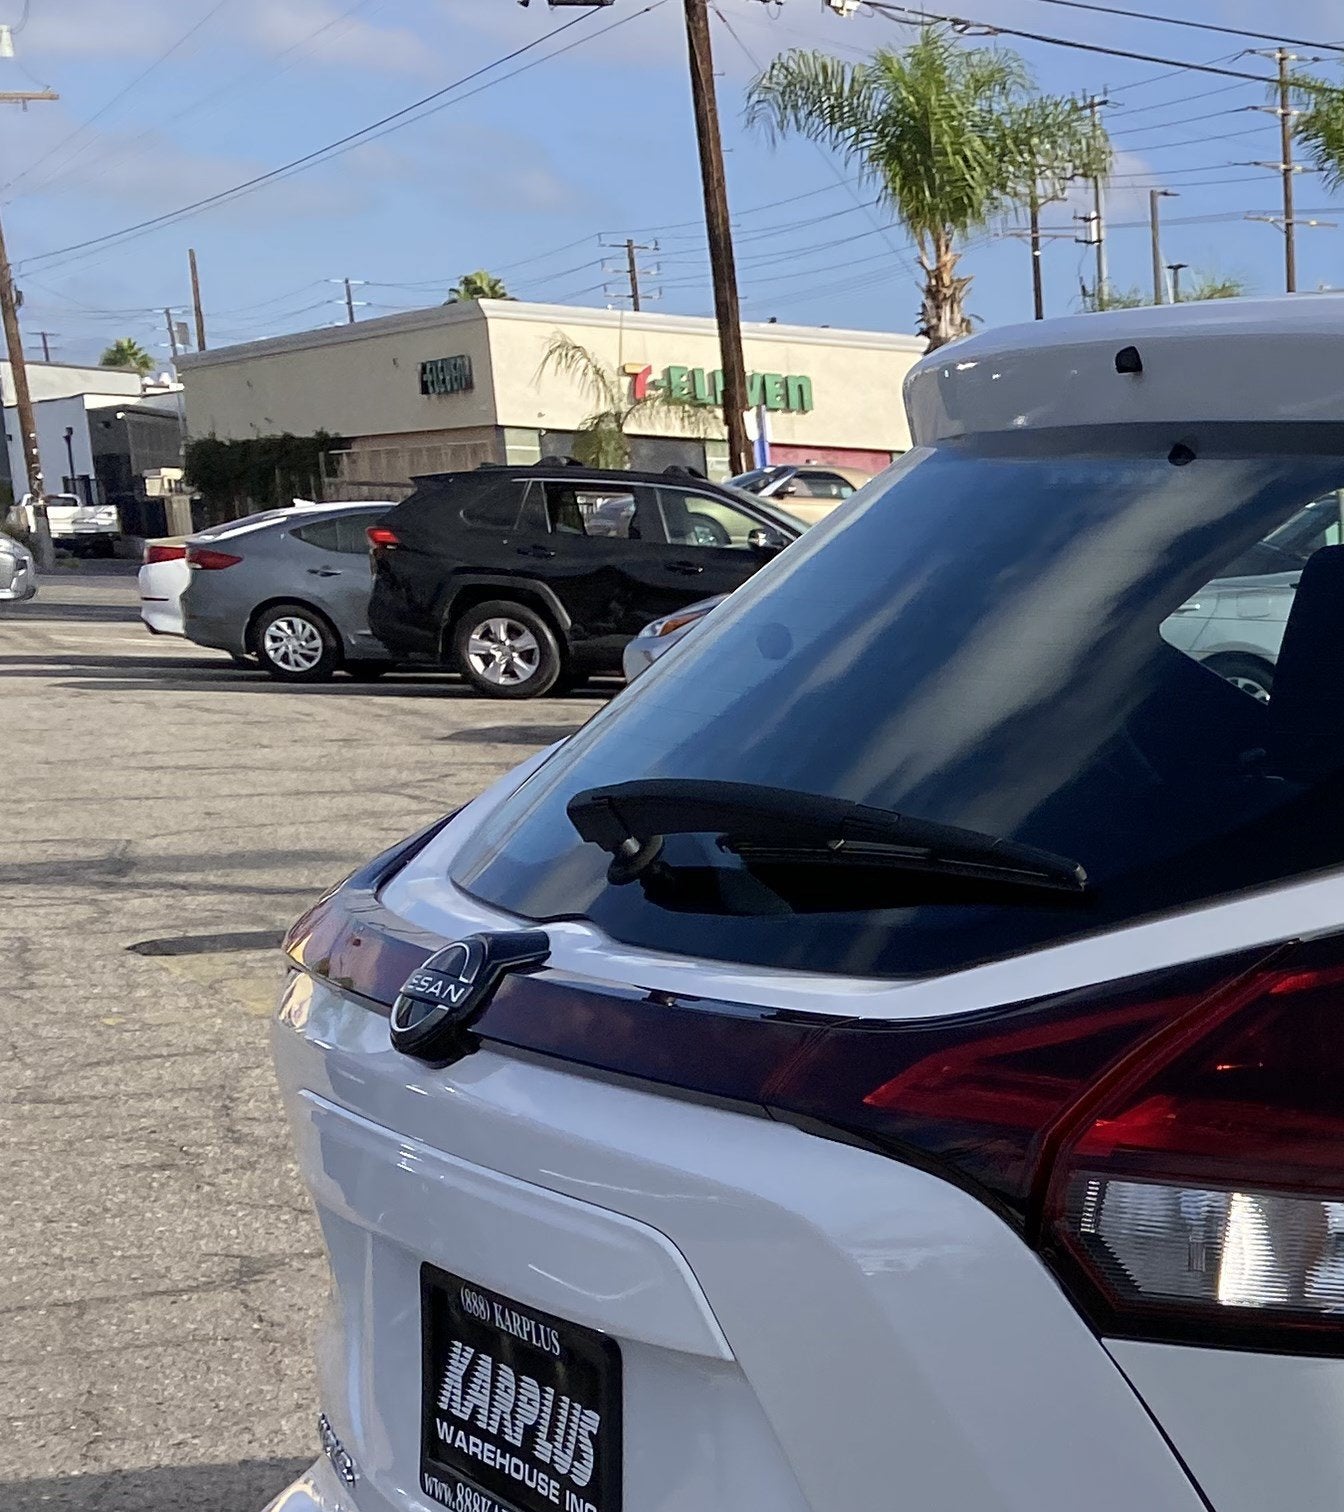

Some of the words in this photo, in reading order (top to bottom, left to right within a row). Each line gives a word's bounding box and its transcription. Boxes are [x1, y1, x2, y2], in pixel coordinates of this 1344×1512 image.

[624, 363, 813, 415] 7-ELVEn
[460, 1285, 490, 1321] (888)
[494, 1302, 561, 1356] KARPLUS
[437, 1340, 600, 1488] KARPLUS
[435, 1417, 560, 1504] WAREHOUSE
